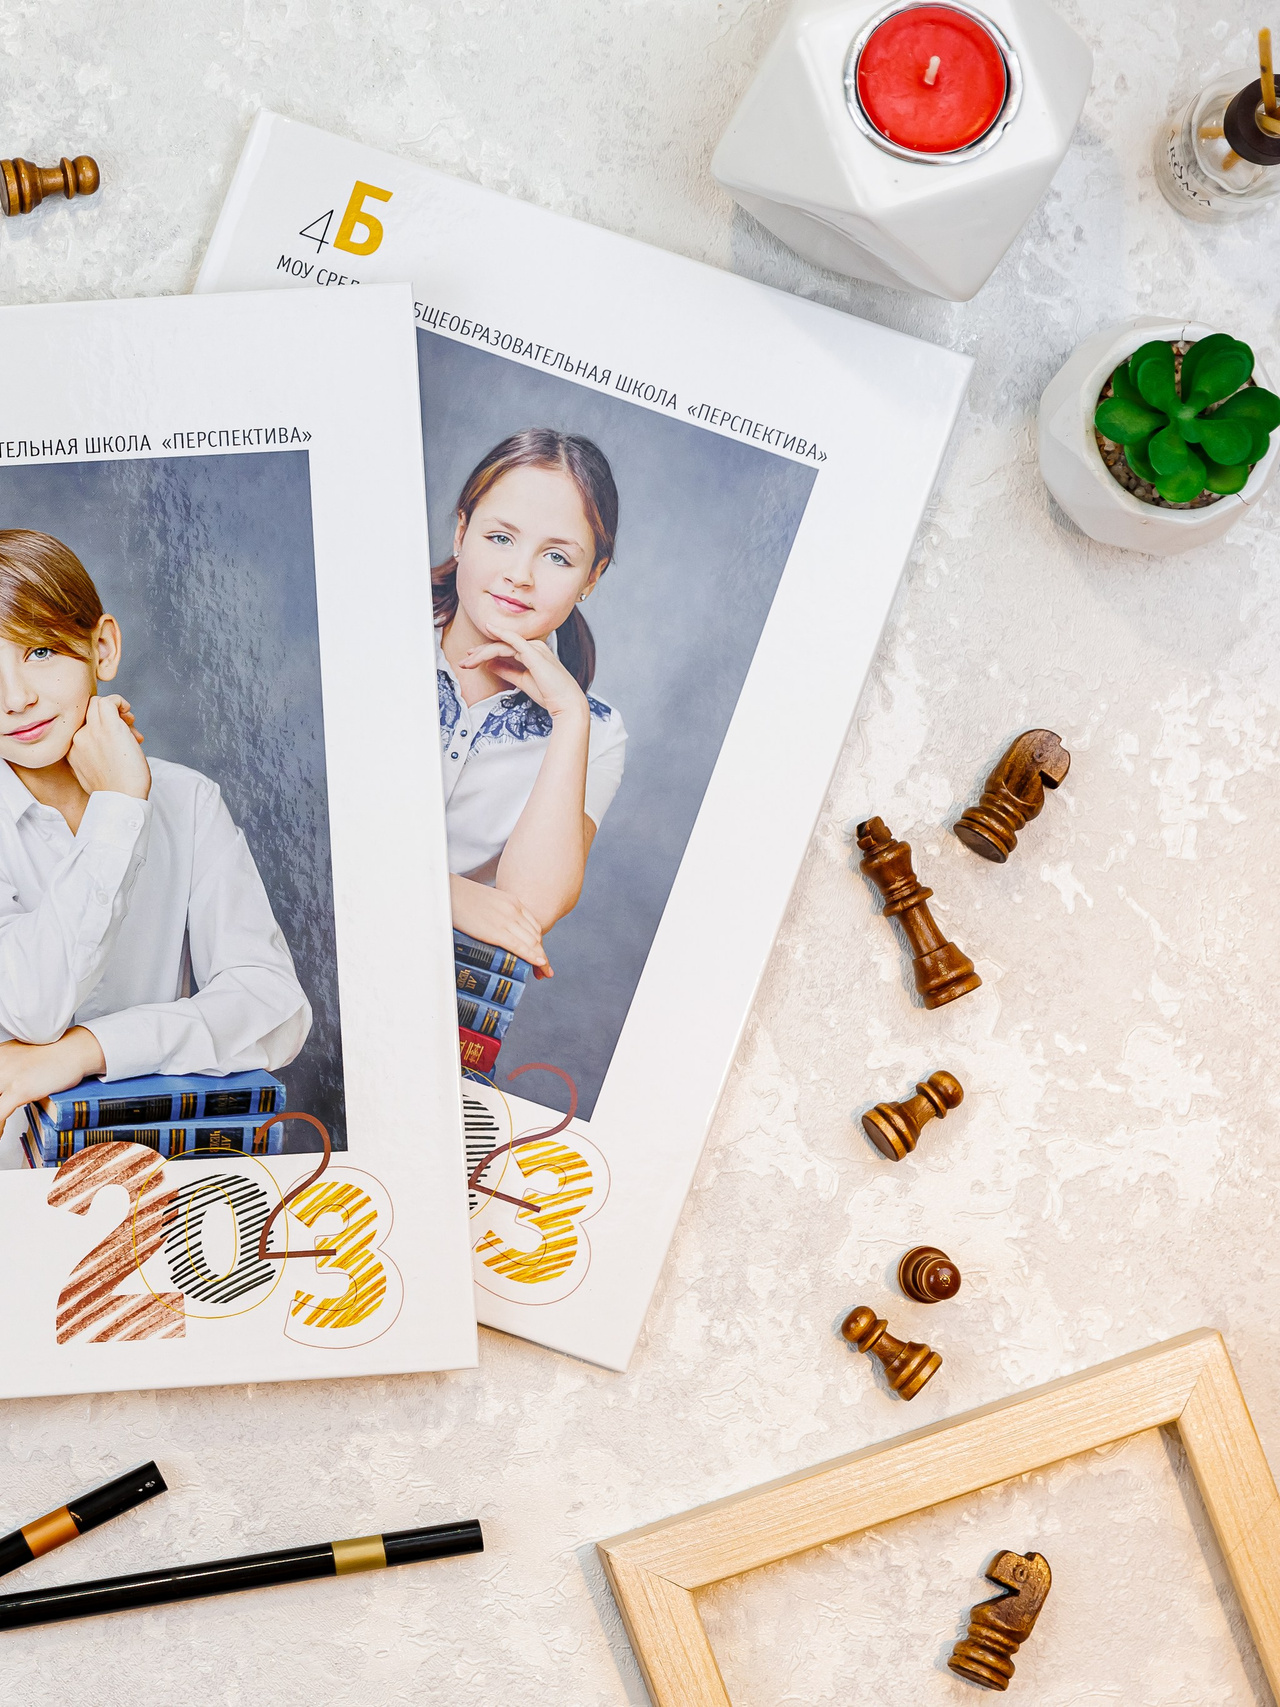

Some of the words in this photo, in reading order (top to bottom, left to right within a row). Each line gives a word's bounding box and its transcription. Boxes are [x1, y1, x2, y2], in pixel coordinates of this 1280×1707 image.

[298, 180, 394, 256] 4Б
[276, 254, 315, 279] МОУ
[316, 268, 361, 287] СРЕ
[615, 374, 678, 411] ШКОЛА
[687, 403, 828, 462] «ПЕРСПЕКТИВА»
[85, 435, 152, 454] ШКОЛА
[162, 426, 312, 450] «ПЕРСПЕКТИВА»
